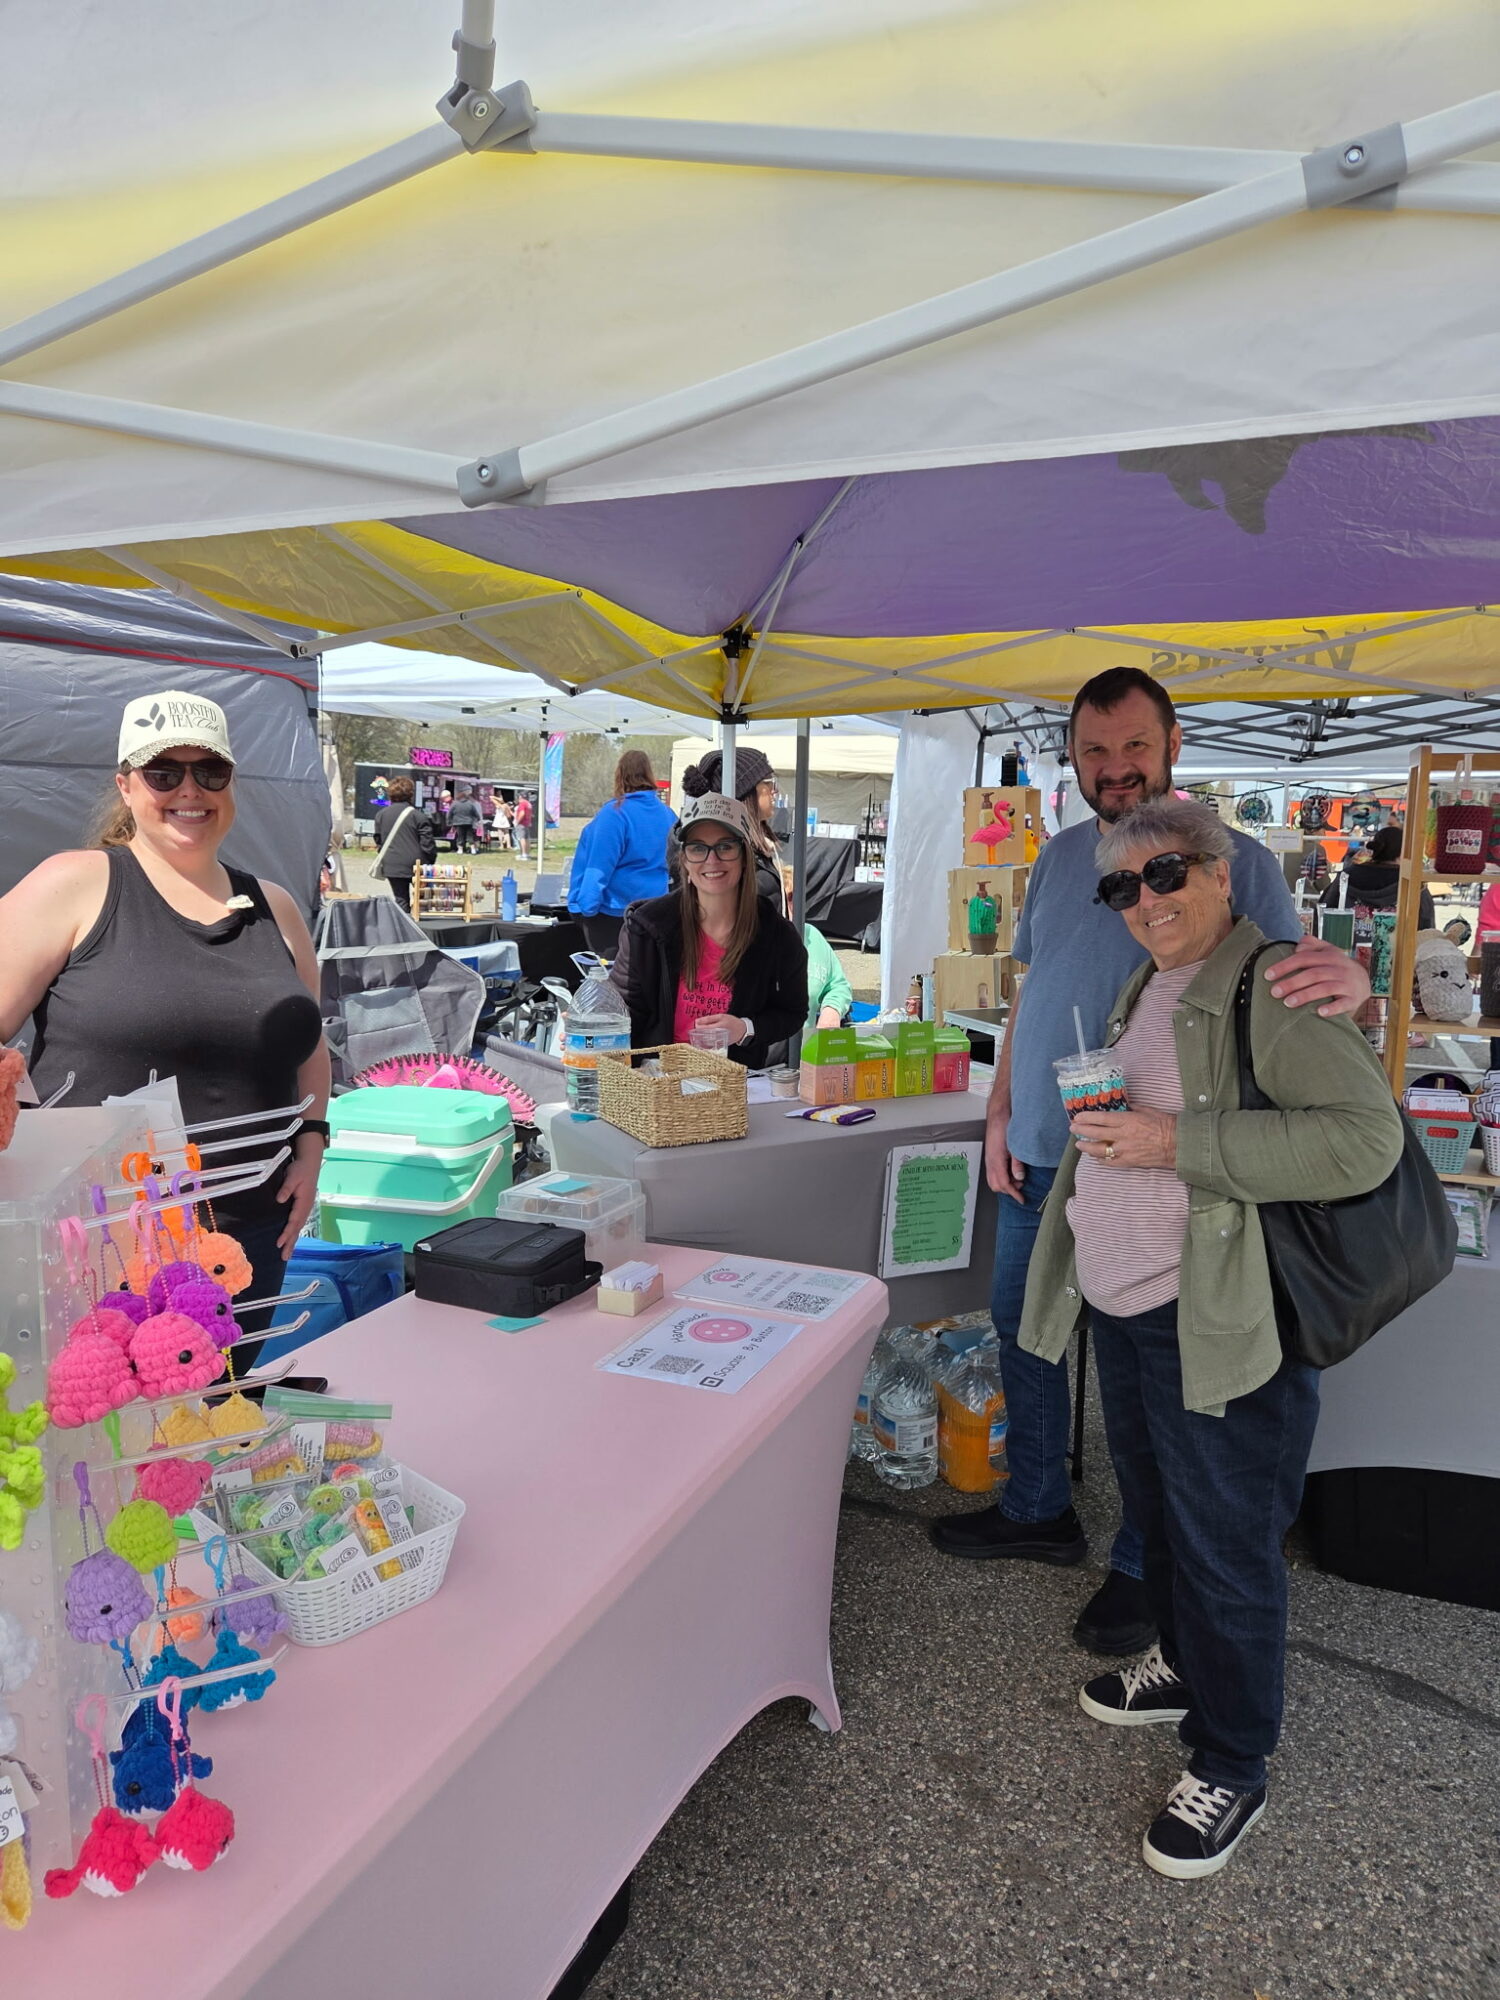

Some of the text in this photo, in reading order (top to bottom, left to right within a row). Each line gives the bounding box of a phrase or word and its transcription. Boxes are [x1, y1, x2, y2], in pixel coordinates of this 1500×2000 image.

[168, 702, 217, 722] BOOSTED
[170, 714, 219, 733] TEA Club
[671, 1312, 709, 1344] Handmade
[742, 1325, 777, 1352] By Button
[616, 1346, 654, 1369] Cash
[713, 1353, 746, 1378] Square
